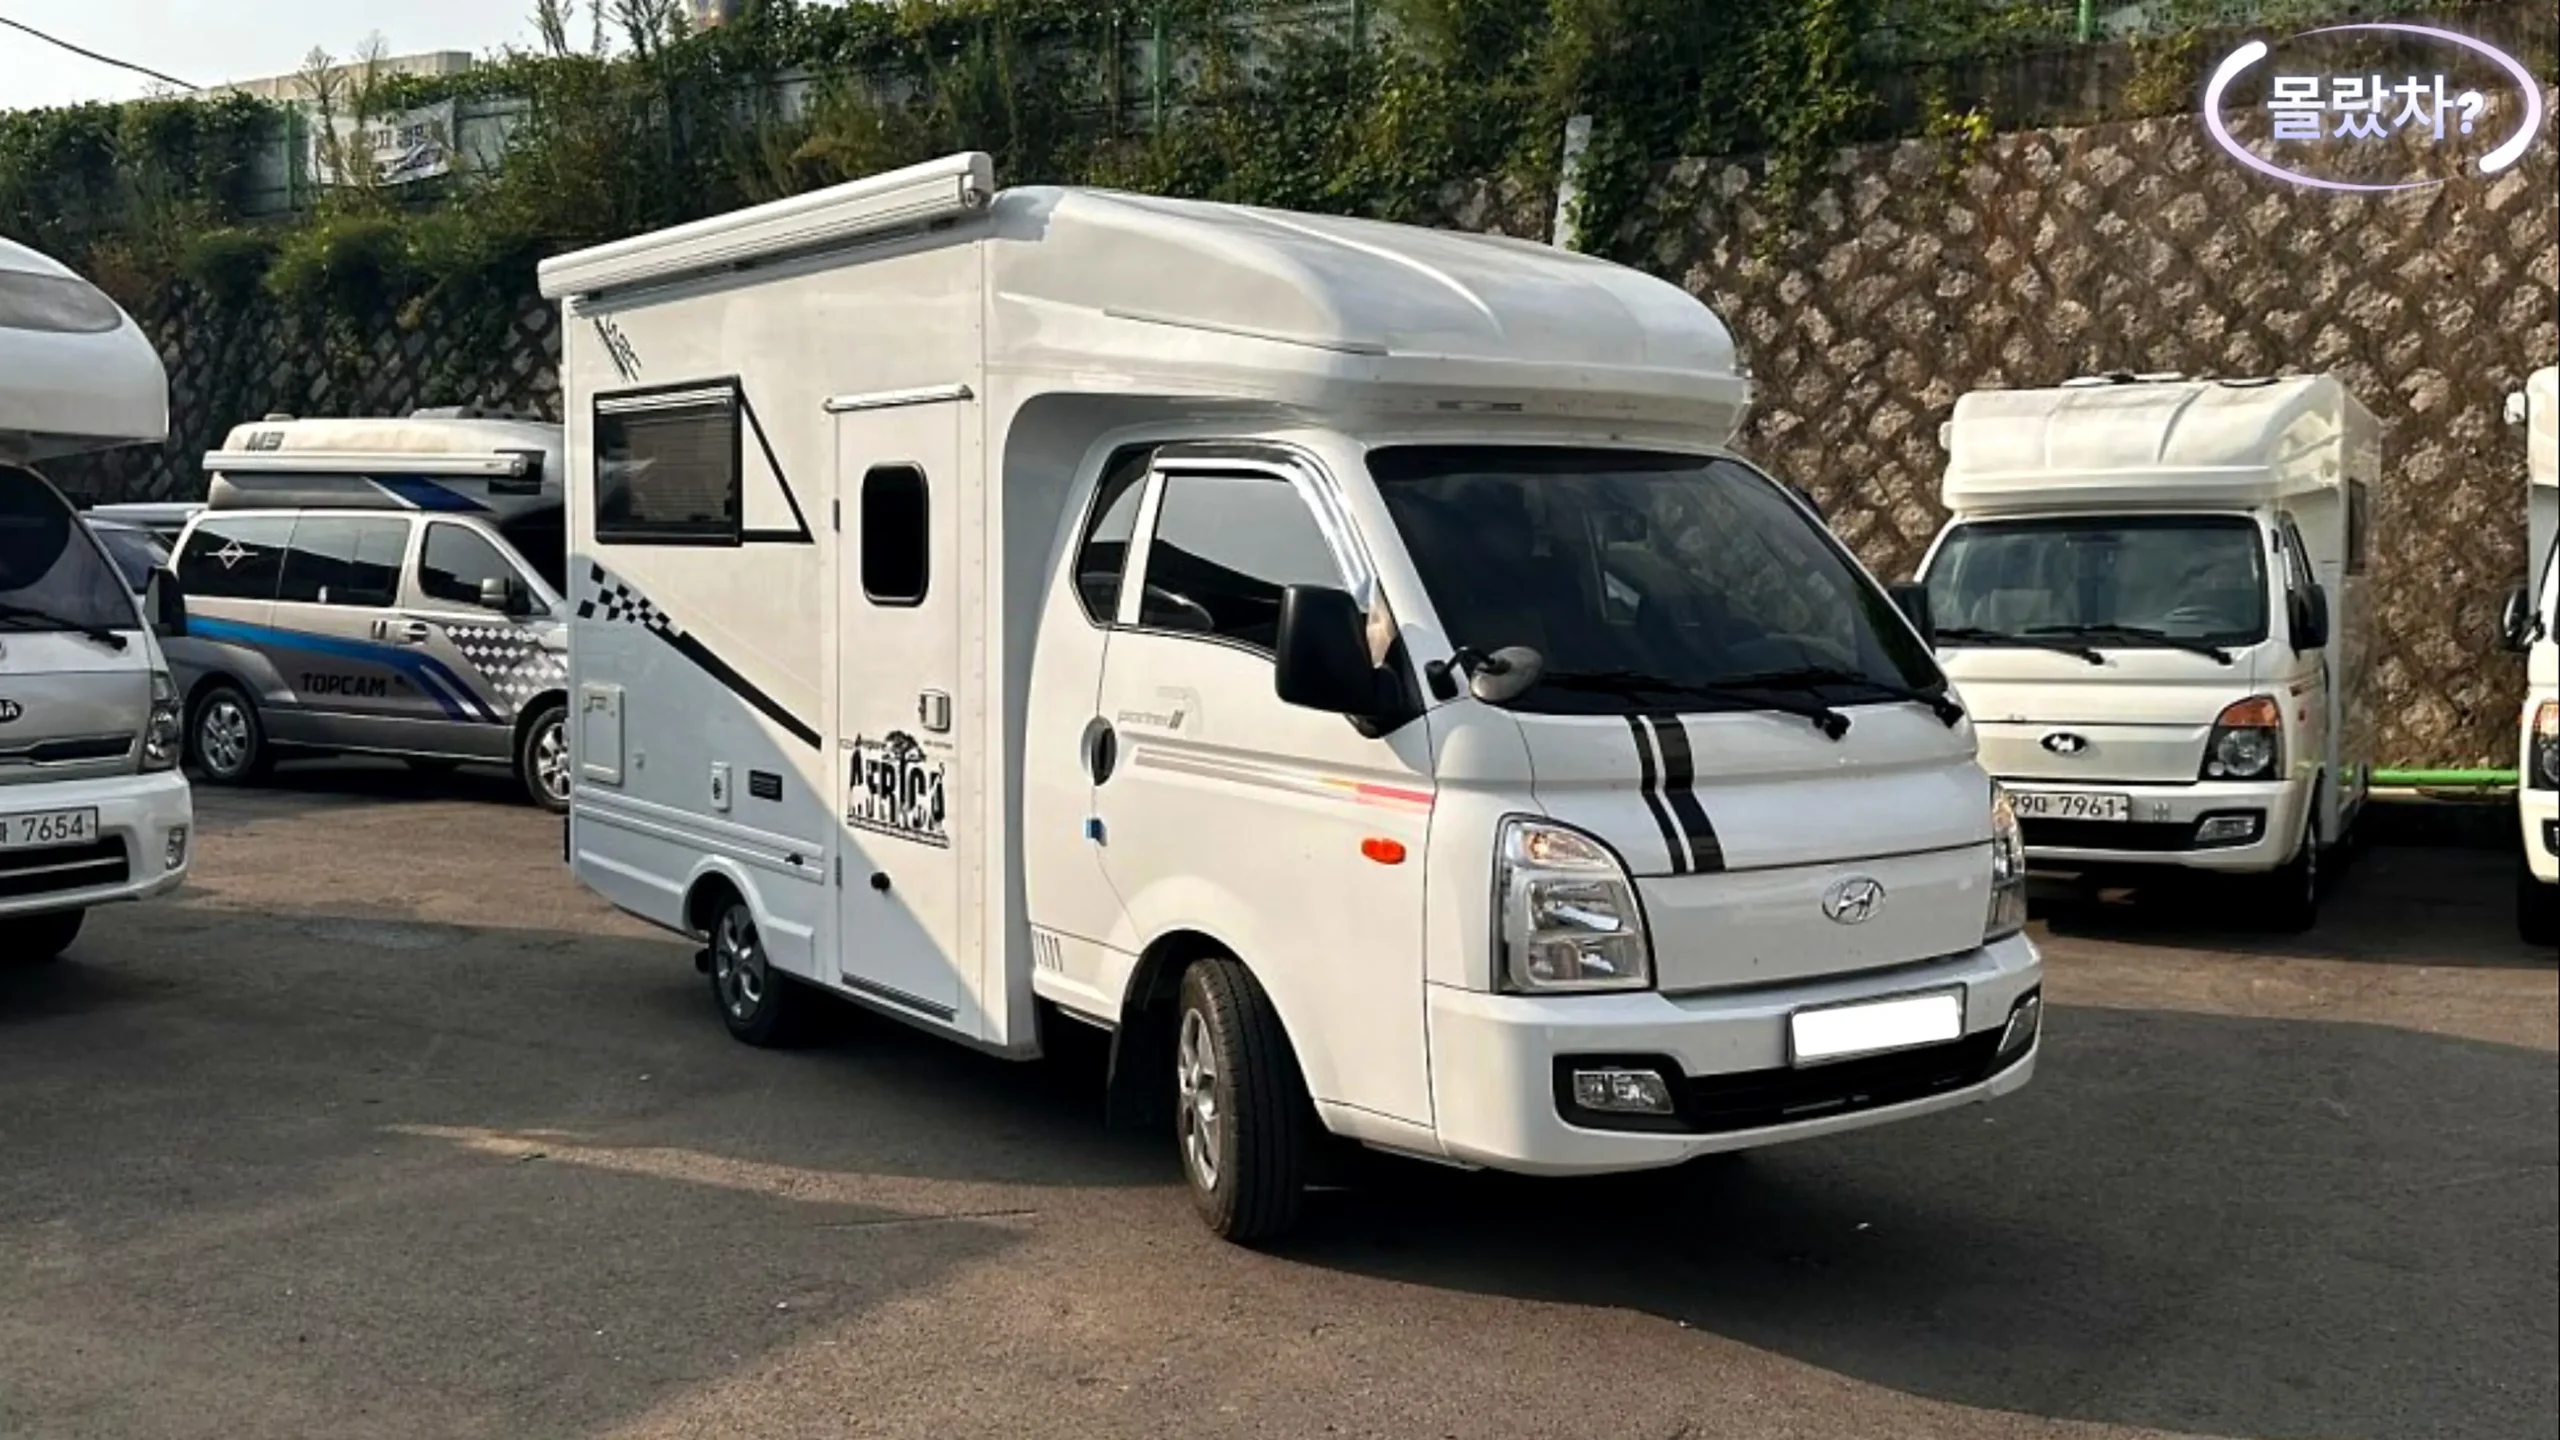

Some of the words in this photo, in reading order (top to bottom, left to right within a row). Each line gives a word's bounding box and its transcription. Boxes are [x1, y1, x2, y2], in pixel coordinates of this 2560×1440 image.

[300, 672, 386, 697] TOPCAM
[2059, 796, 2115, 818] 7961
[21, 814, 84, 842] 7654
